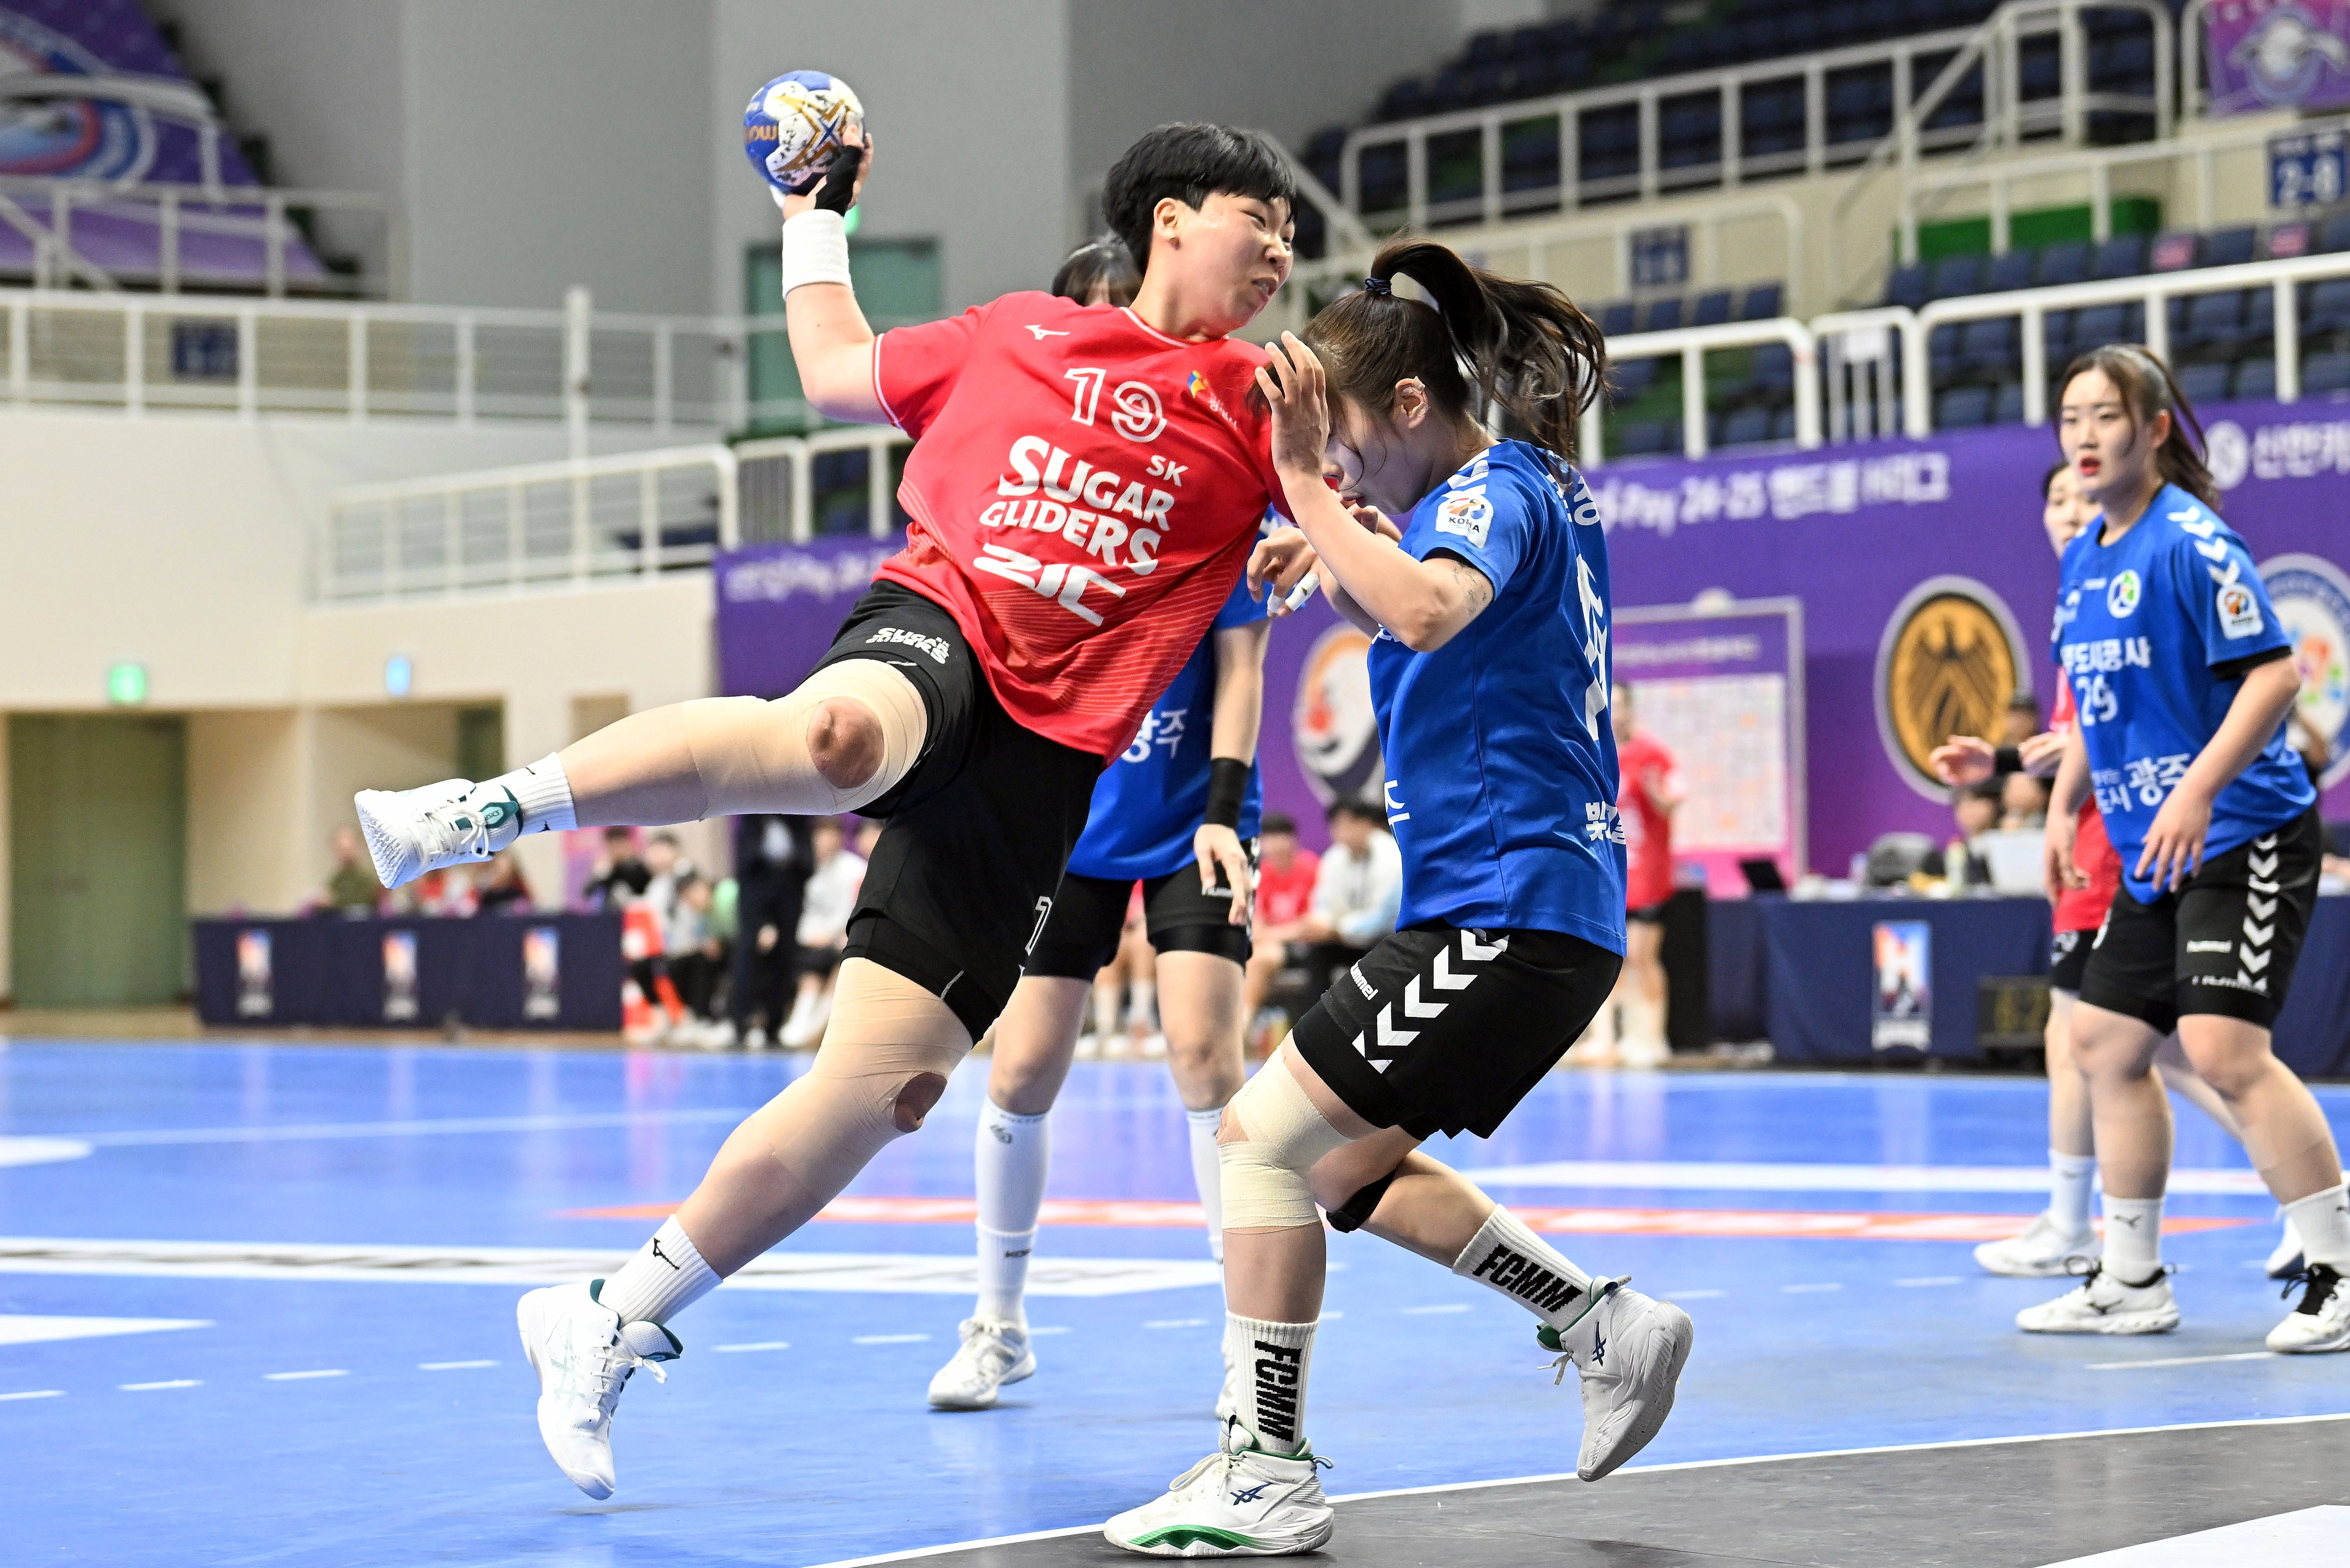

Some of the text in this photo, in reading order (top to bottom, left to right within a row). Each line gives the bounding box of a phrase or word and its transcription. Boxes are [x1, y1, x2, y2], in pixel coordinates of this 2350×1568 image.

[1064, 367, 1167, 442] 19
[997, 435, 1174, 531] SUGAR
[1146, 455, 1189, 486] SK
[979, 500, 1161, 575] GLIDERS
[865, 636, 946, 664] GLIDERS
[872, 627, 949, 657] SUGAR
[2076, 674, 2118, 726] 29
[2124, 753, 2191, 806] 광주
[1350, 959, 1379, 1000] ummel
[1472, 1243, 1582, 1313] FCMM
[1255, 1340, 1302, 1443] FCMM
